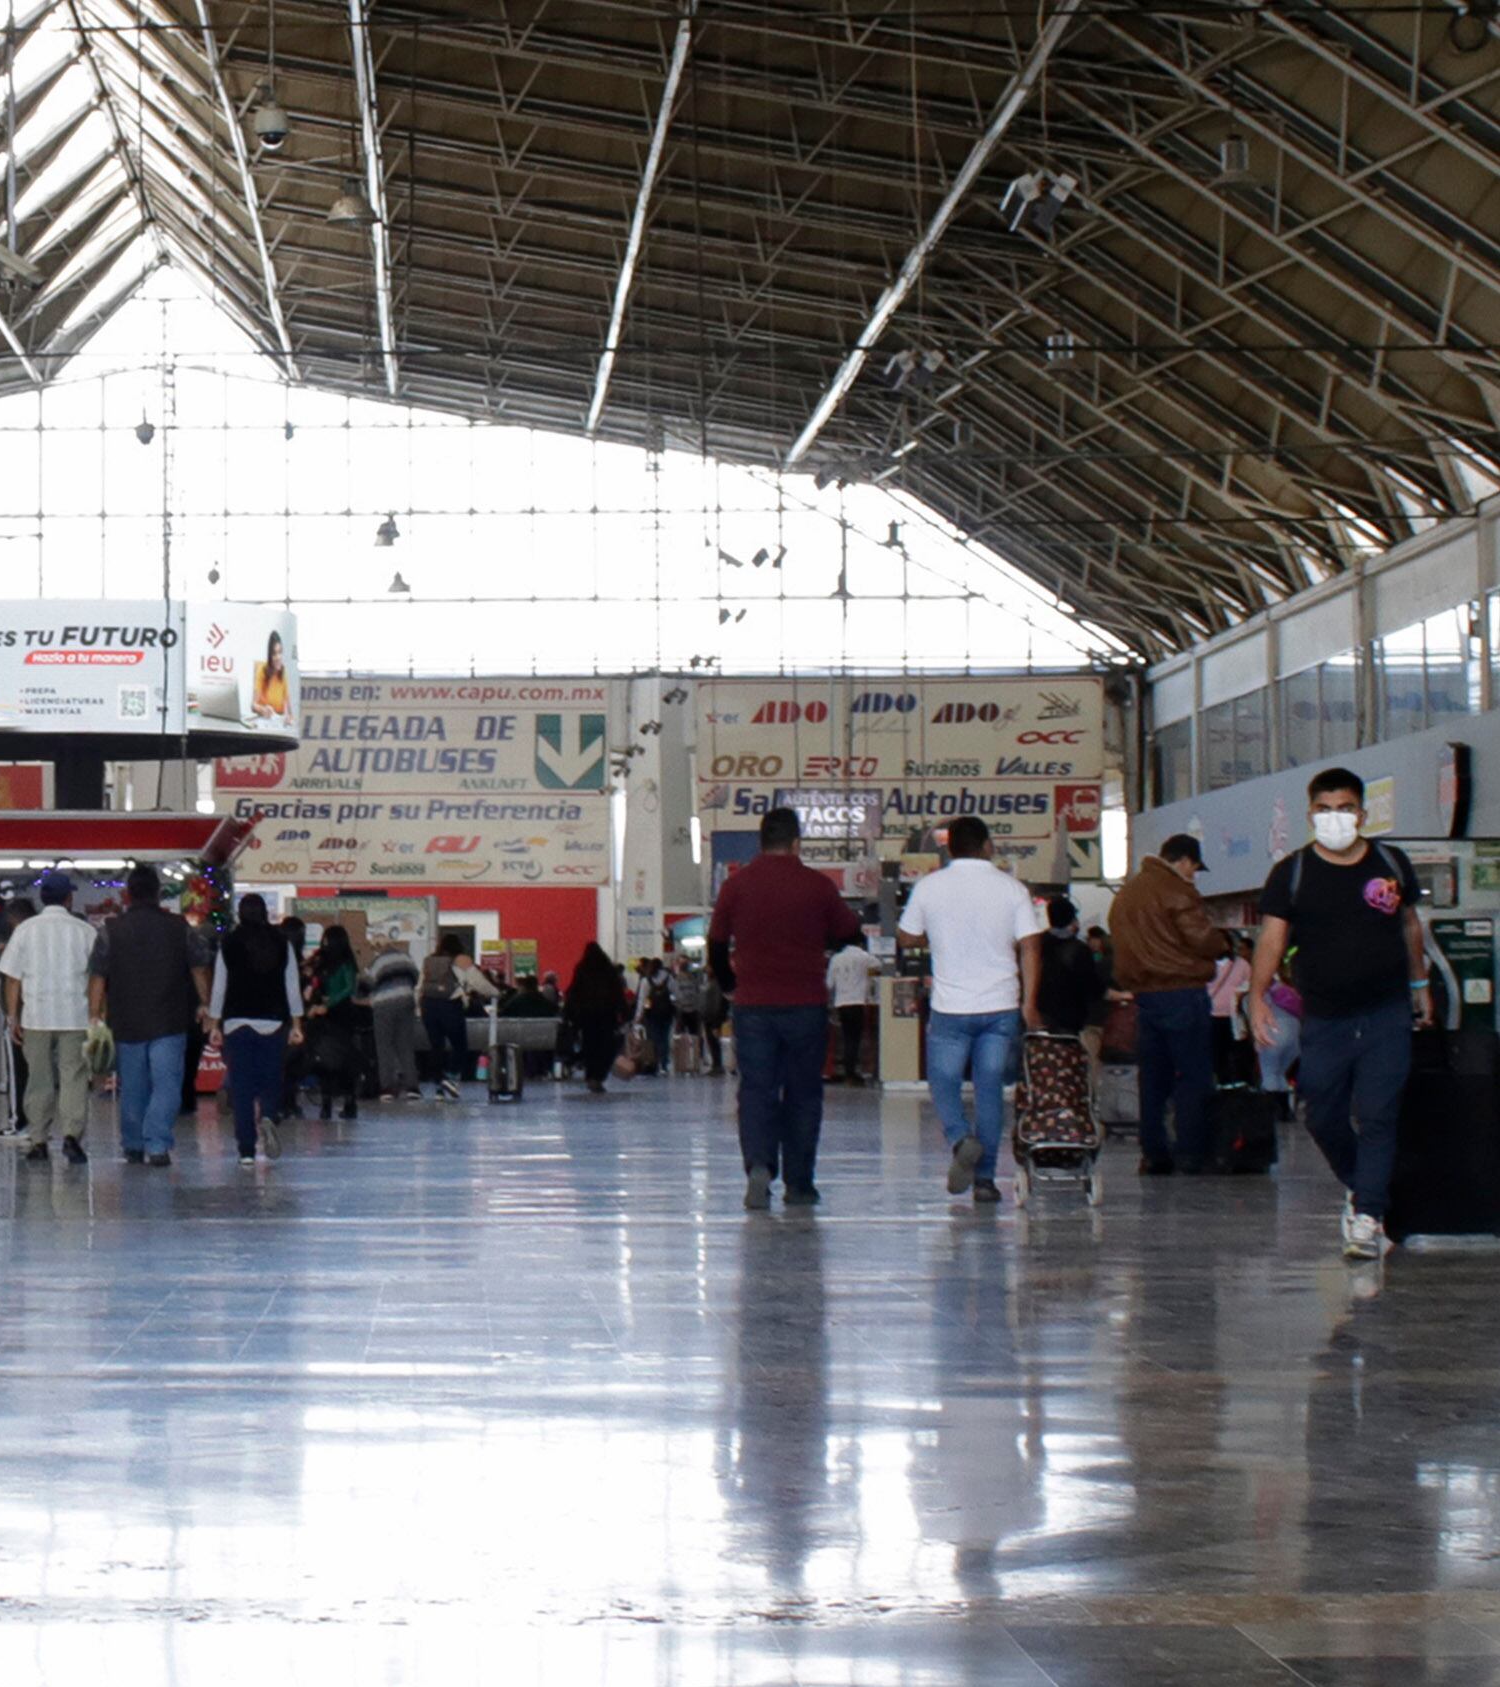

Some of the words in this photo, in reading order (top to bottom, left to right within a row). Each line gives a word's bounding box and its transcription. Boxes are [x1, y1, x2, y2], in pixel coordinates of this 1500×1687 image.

[24, 631, 54, 646] TU
[61, 626, 178, 648] FUTURO
[32, 652, 65, 664] Hazlo
[390, 684, 605, 702] www.capu.com.mx
[850, 693, 916, 713] ADO
[751, 701, 828, 724] ADO
[931, 703, 1000, 724] ADO
[301, 715, 447, 741] LLEGADA
[475, 716, 517, 741] DE
[308, 748, 497, 773] AUTOBUSES
[711, 755, 783, 777] ORO
[904, 760, 981, 776] Surianos
[235, 798, 331, 819] Gracias
[337, 803, 382, 824] por
[389, 804, 421, 820] su
[426, 800, 581, 820] Preferencia
[883, 787, 1048, 815] Autobuses
[795, 806, 866, 823] TACOS
[260, 861, 298, 874] ORO
